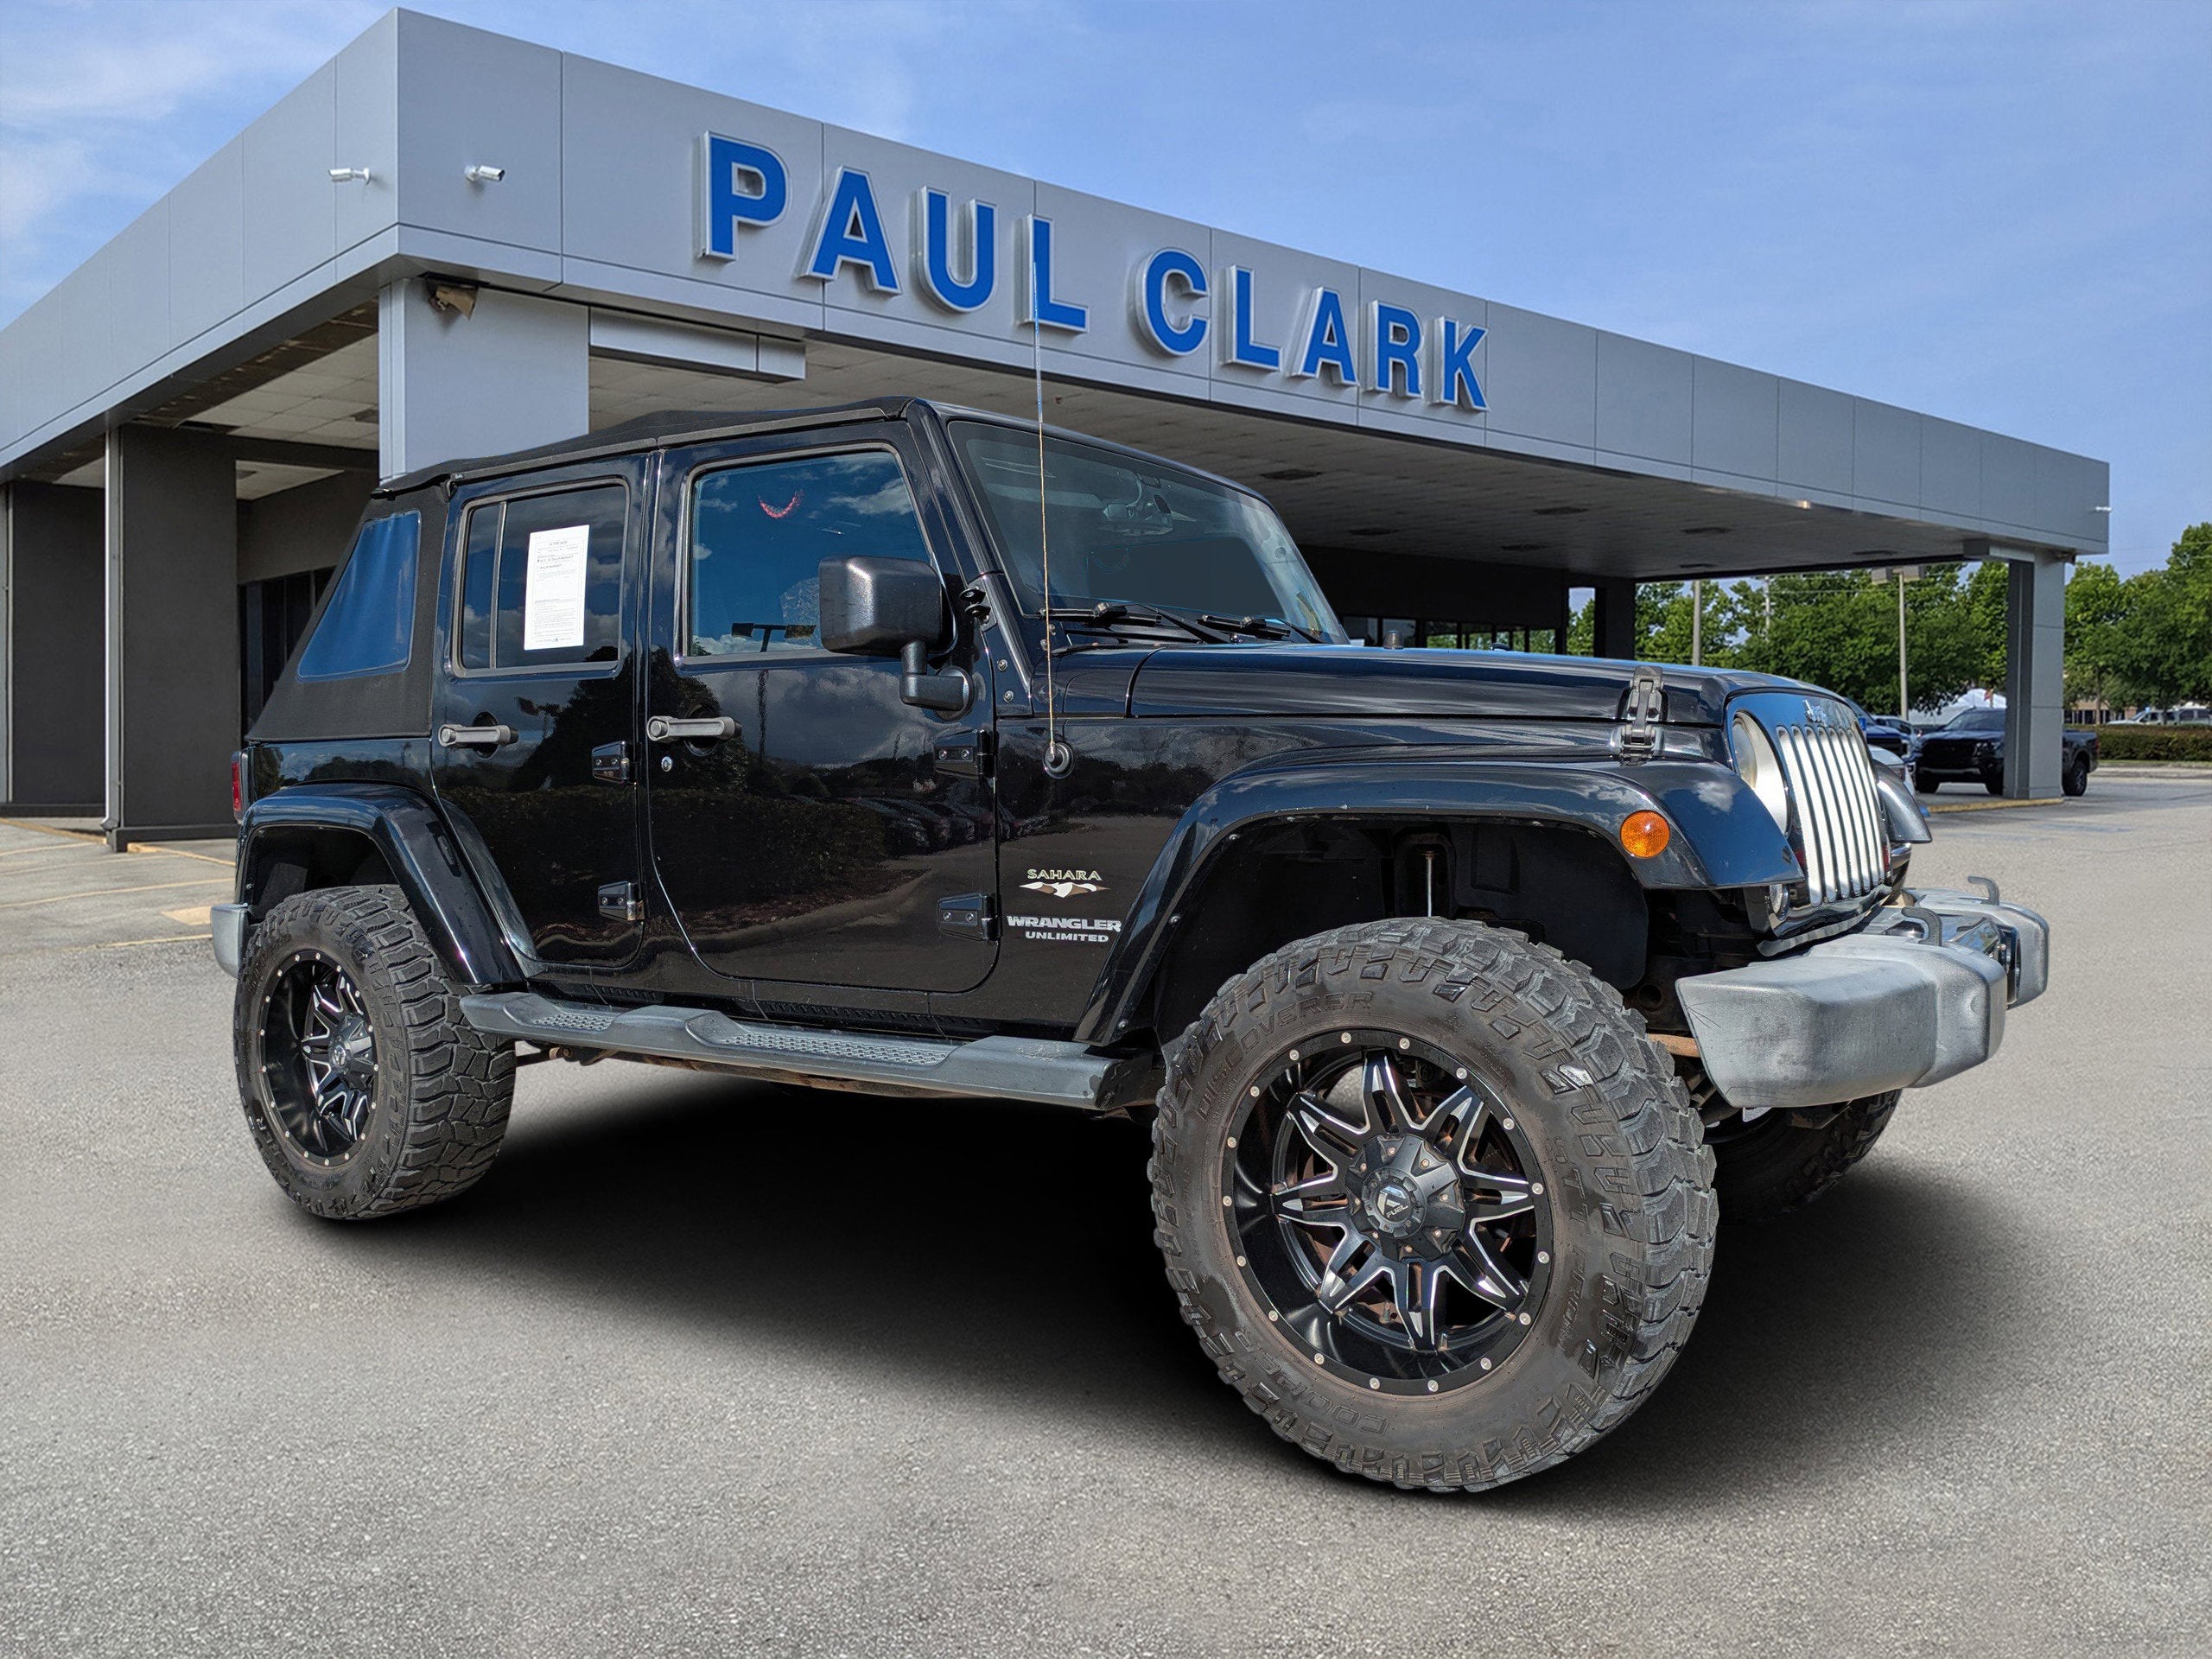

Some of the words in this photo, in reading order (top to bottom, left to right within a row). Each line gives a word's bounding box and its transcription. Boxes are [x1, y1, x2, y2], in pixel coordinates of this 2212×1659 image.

[699, 130, 1089, 334] PAUL
[1133, 245, 1490, 412] CLARK
[1027, 868, 1103, 881] SAHARA
[1006, 915, 1122, 932] WRANGLER
[1025, 931, 1109, 943] UNLIMITED
[1196, 991, 1373, 1121] DISCOVERER
[1386, 1205, 1408, 1218] FUEL
[1235, 1330, 1389, 1436] COOPER
